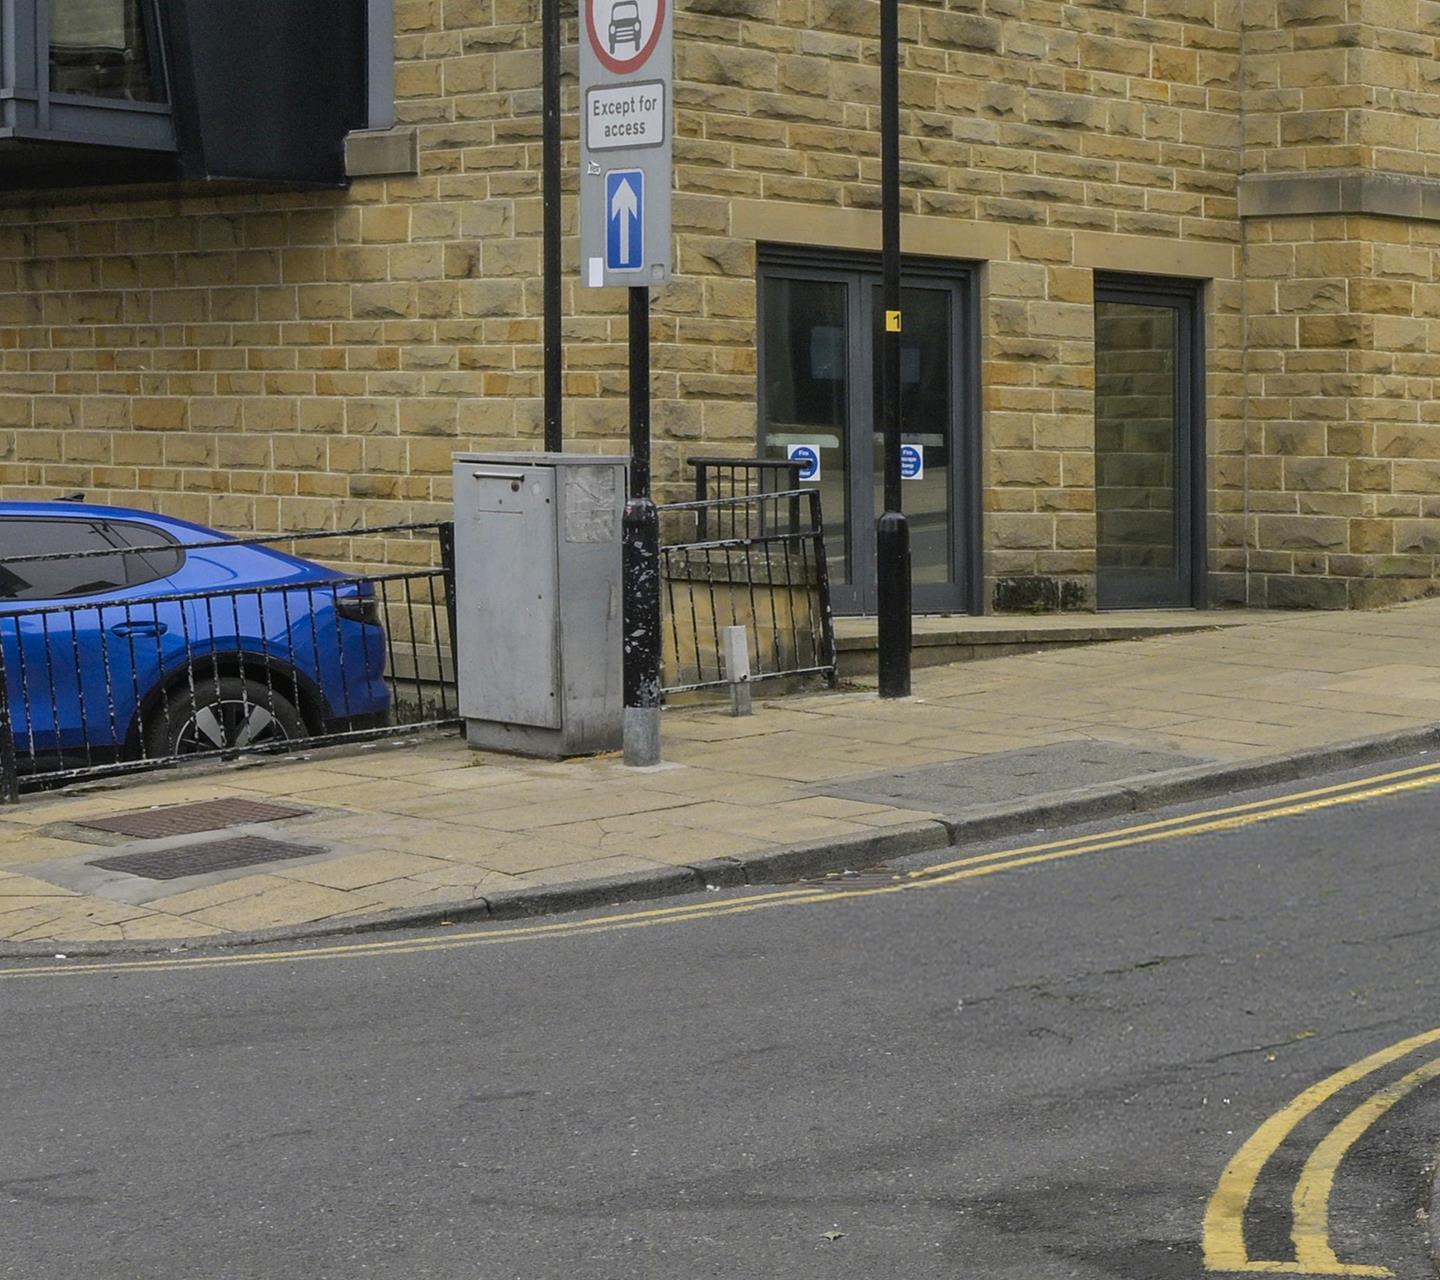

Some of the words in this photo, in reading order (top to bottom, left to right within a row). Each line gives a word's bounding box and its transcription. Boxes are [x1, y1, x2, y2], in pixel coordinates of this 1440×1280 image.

[593, 96, 635, 117] Except
[639, 96, 657, 112] for
[604, 122, 646, 137] access
